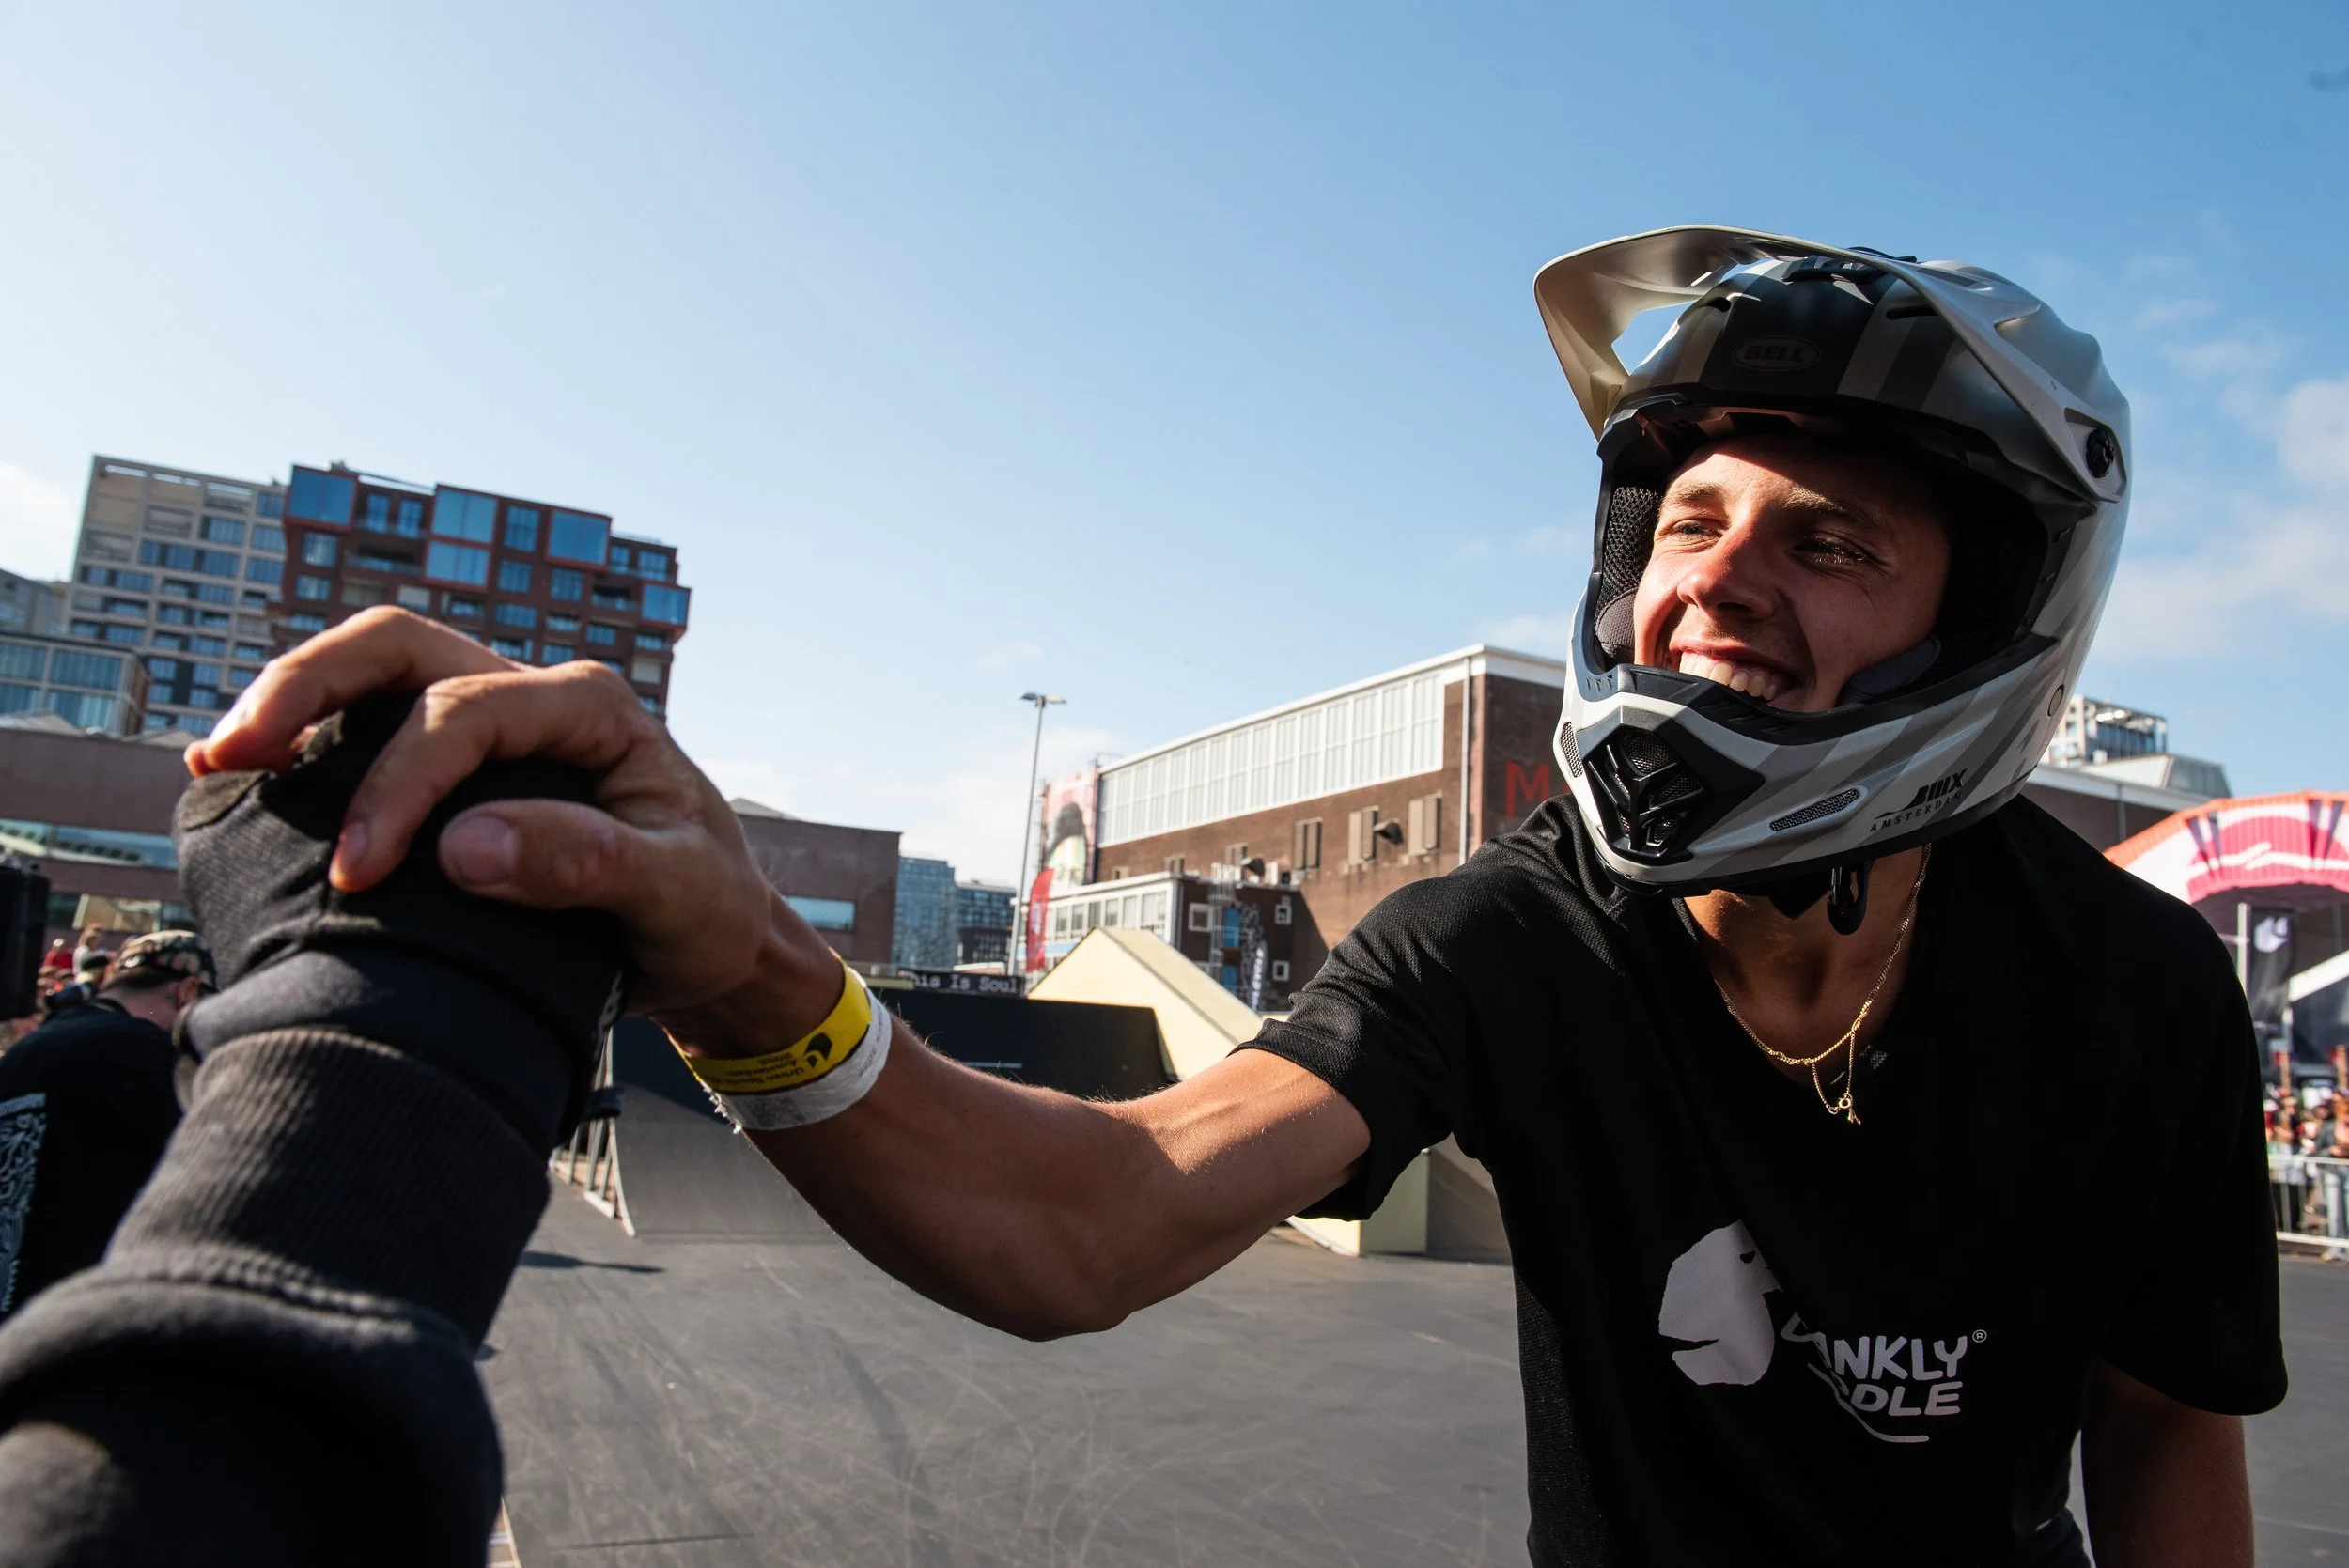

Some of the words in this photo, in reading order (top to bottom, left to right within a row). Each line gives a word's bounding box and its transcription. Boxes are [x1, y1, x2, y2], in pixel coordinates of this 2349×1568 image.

[1744, 344, 1804, 362] BELL
[1869, 792, 1964, 832] AMSTERDAM
[949, 974, 971, 990] Is
[978, 976, 1018, 993] Soul
